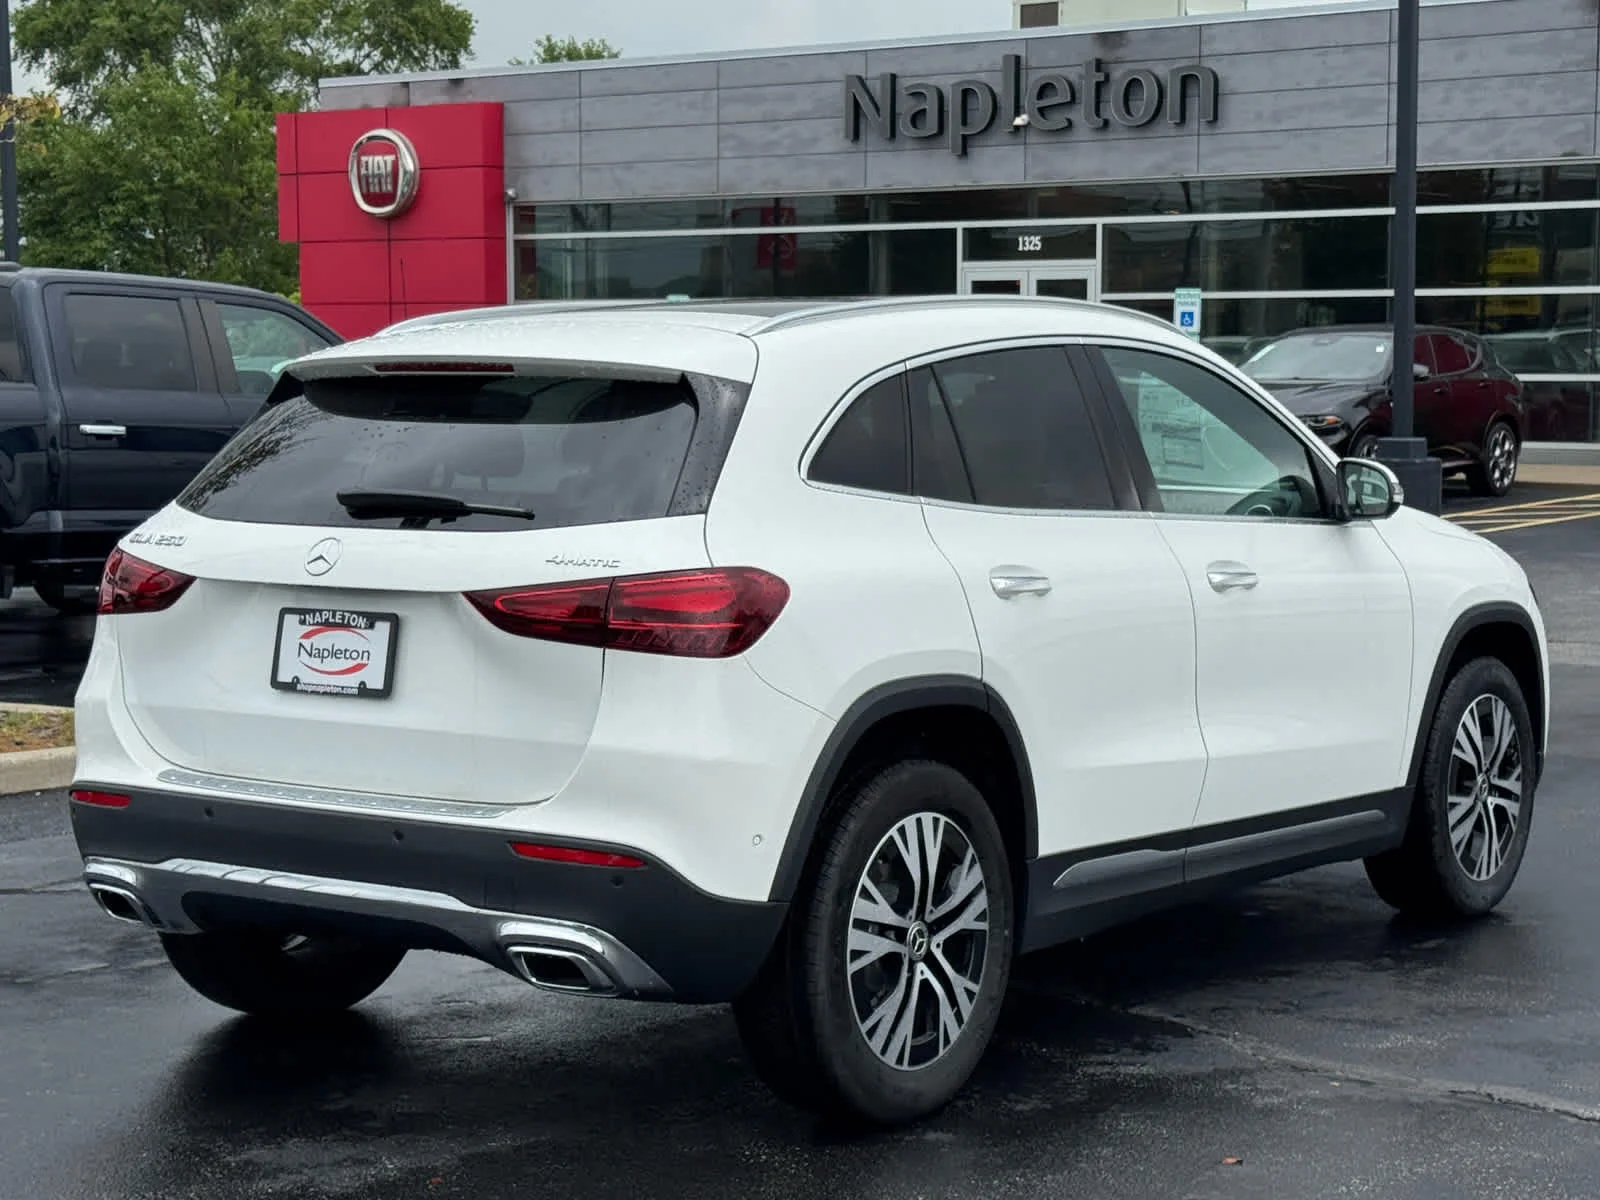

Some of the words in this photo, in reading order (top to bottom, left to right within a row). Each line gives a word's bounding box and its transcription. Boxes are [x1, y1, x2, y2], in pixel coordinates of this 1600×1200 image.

[844, 54, 1219, 156] Napleton
[361, 154, 396, 193] FIAT
[1017, 235, 1042, 251] 1325
[305, 611, 366, 629] NAPLETON
[297, 641, 371, 664] Napleton
